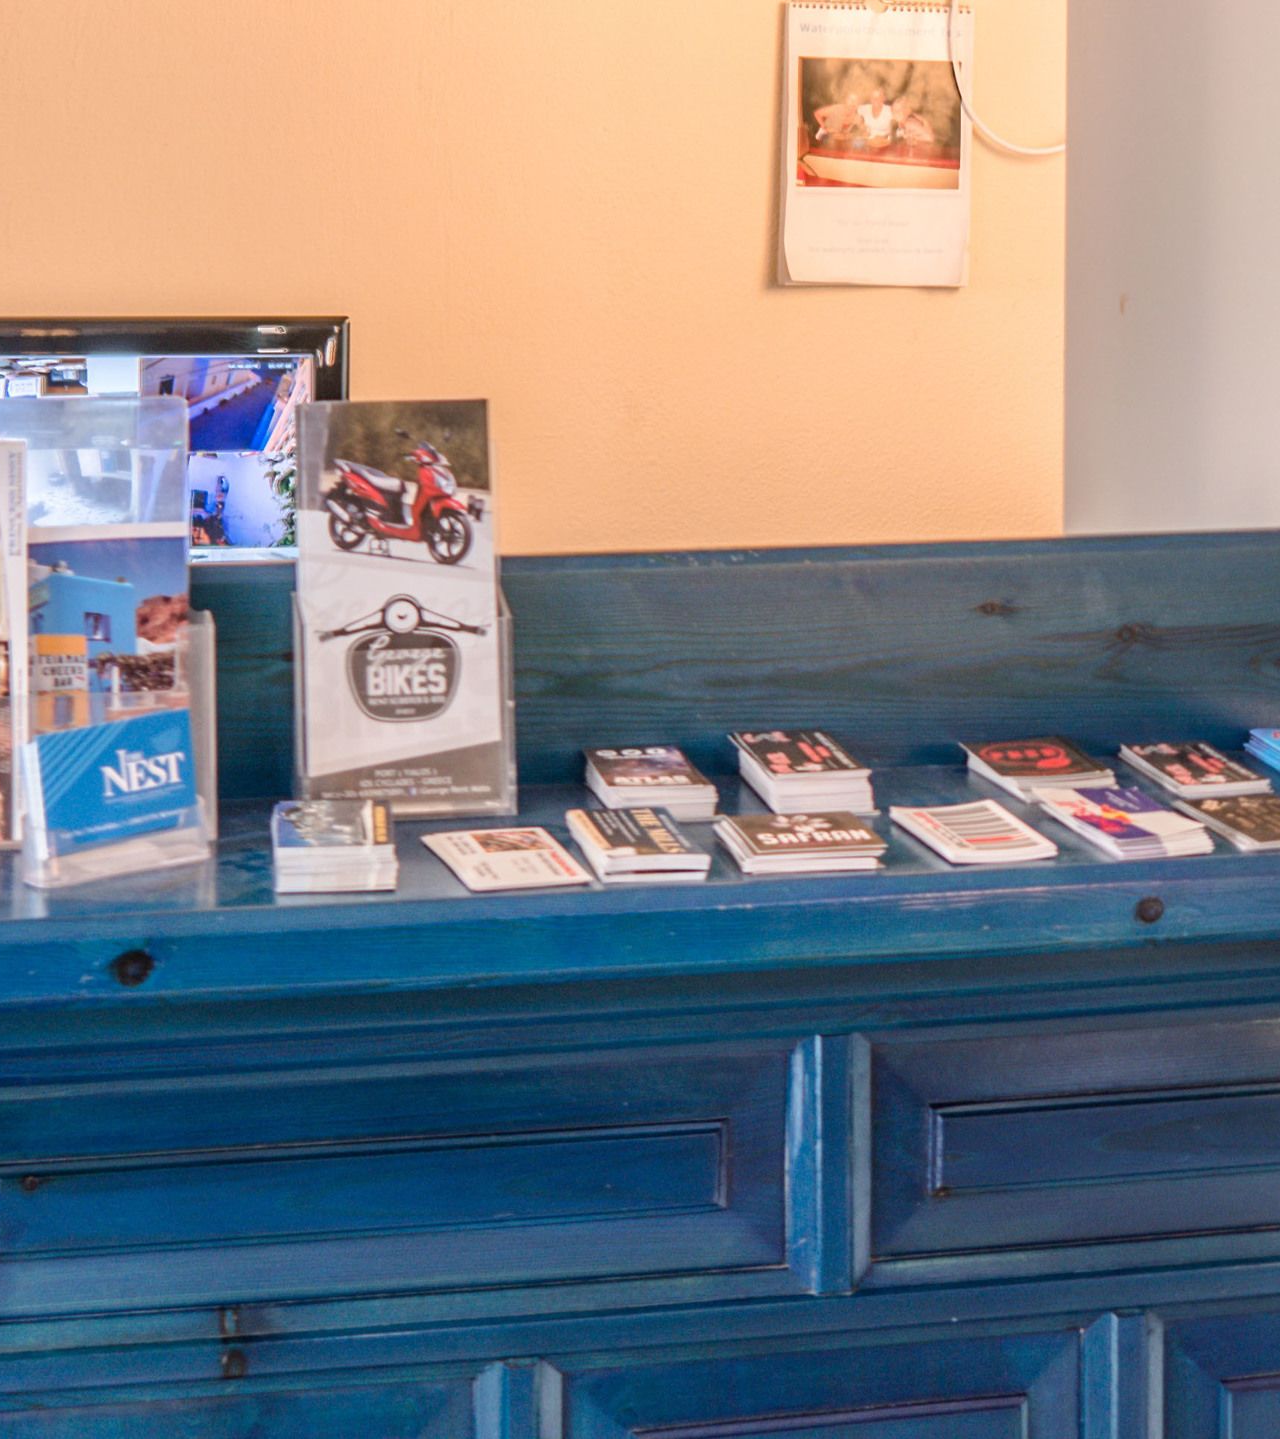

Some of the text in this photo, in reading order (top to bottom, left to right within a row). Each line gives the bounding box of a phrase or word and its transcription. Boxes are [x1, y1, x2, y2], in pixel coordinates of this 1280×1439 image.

[365, 663, 447, 697] BIKES
[100, 750, 186, 798] NEST
[756, 829, 873, 846] SAFRAN
